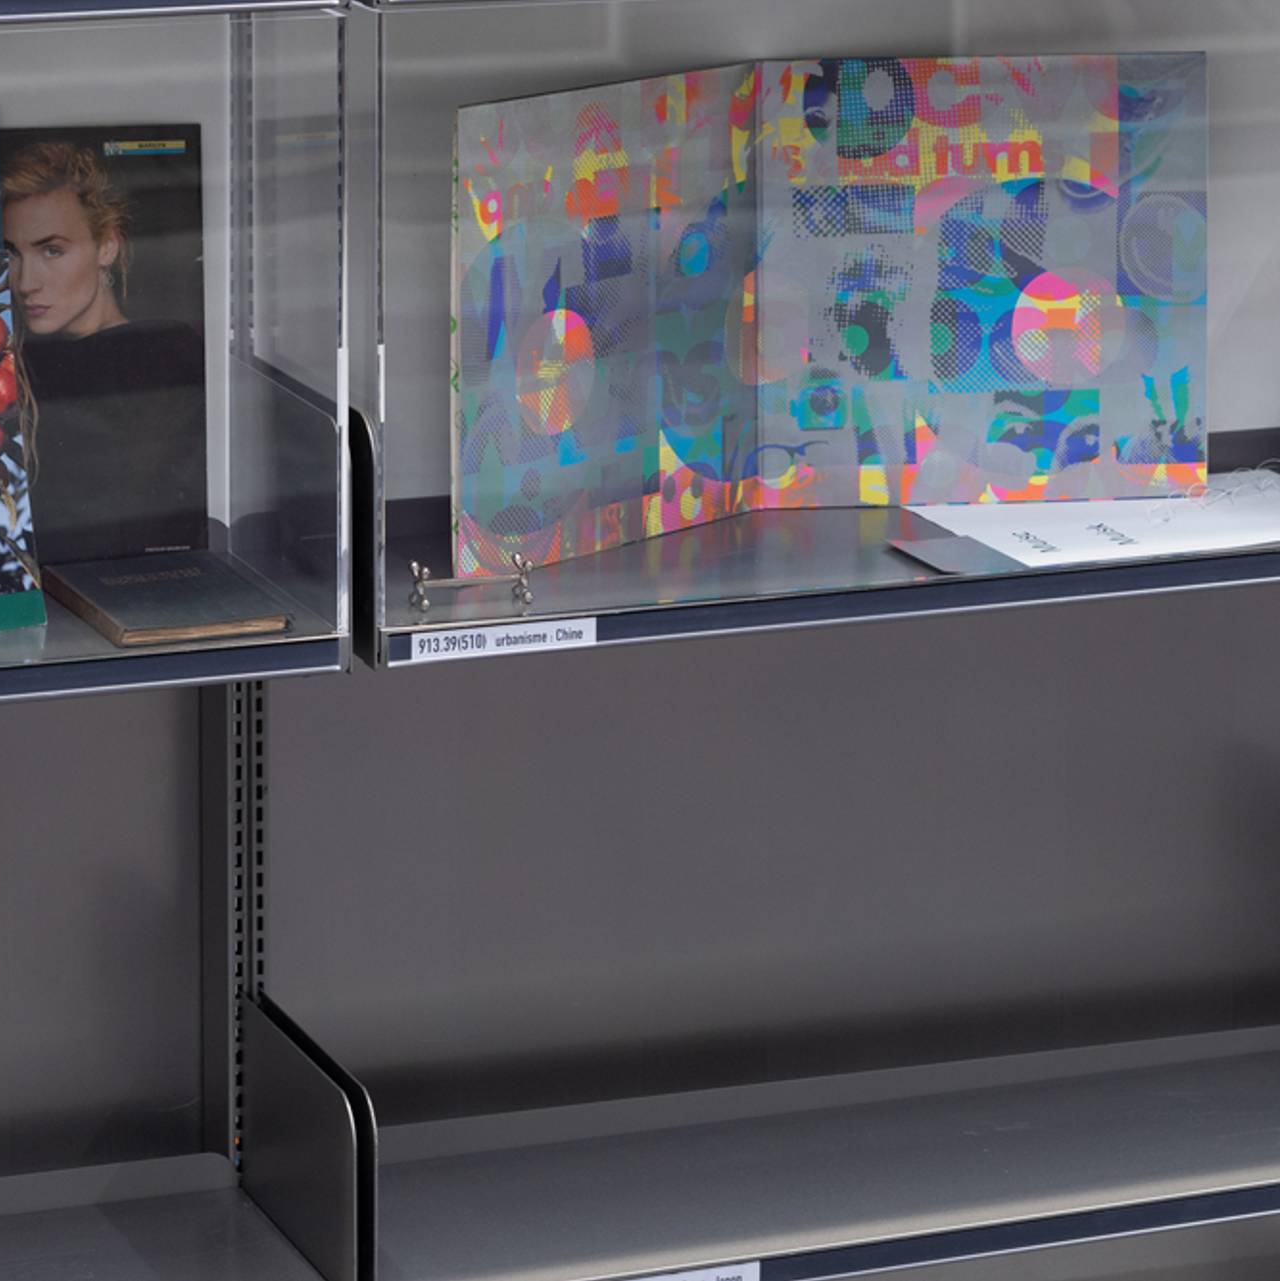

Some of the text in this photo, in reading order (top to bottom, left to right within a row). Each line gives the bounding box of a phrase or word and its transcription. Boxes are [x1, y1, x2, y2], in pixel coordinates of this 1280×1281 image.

[419, 626, 583, 654] 913.39(510) urbanisme Chine
